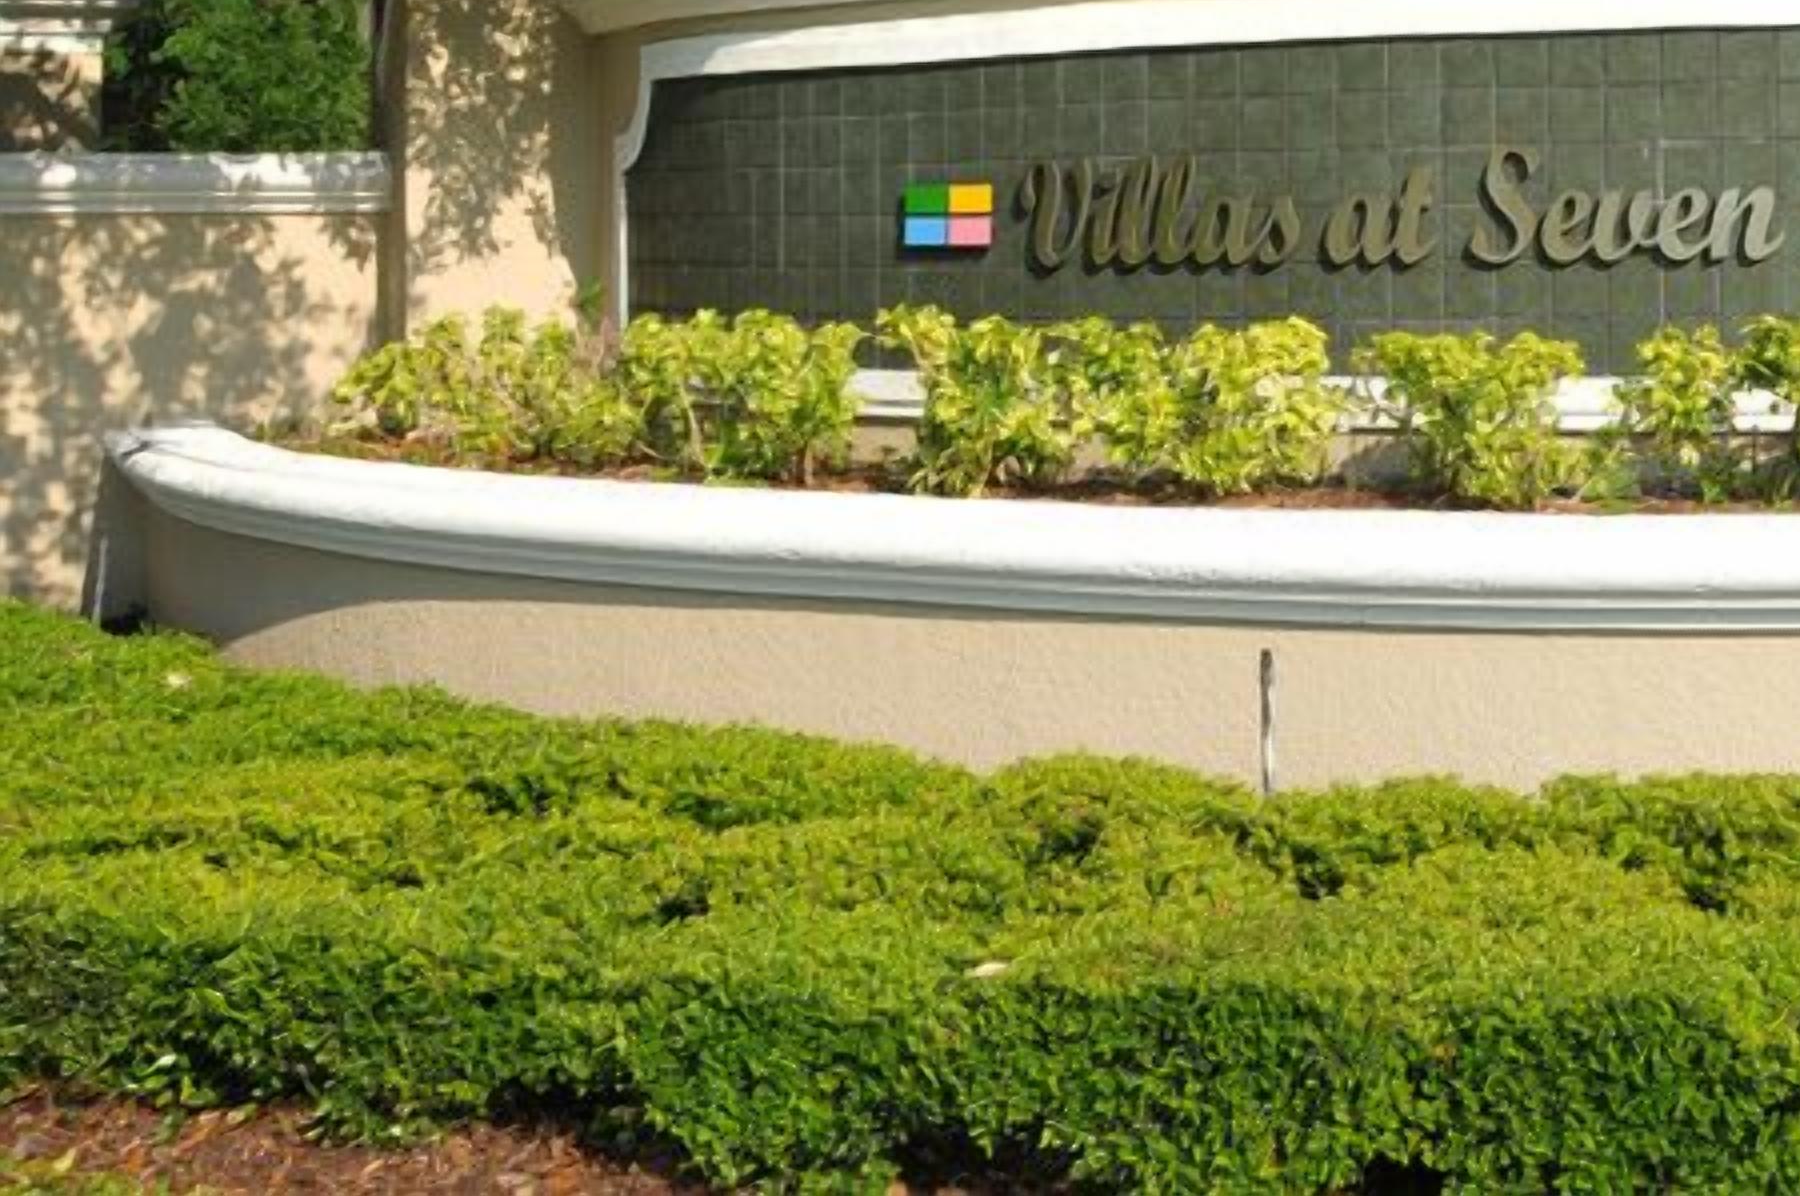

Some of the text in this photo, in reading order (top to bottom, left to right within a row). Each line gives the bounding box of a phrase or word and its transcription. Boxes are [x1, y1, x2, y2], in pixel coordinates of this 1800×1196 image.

[1021, 154, 1302, 267] Villas
[1324, 164, 1437, 266] at
[1469, 142, 1786, 265] Seven
